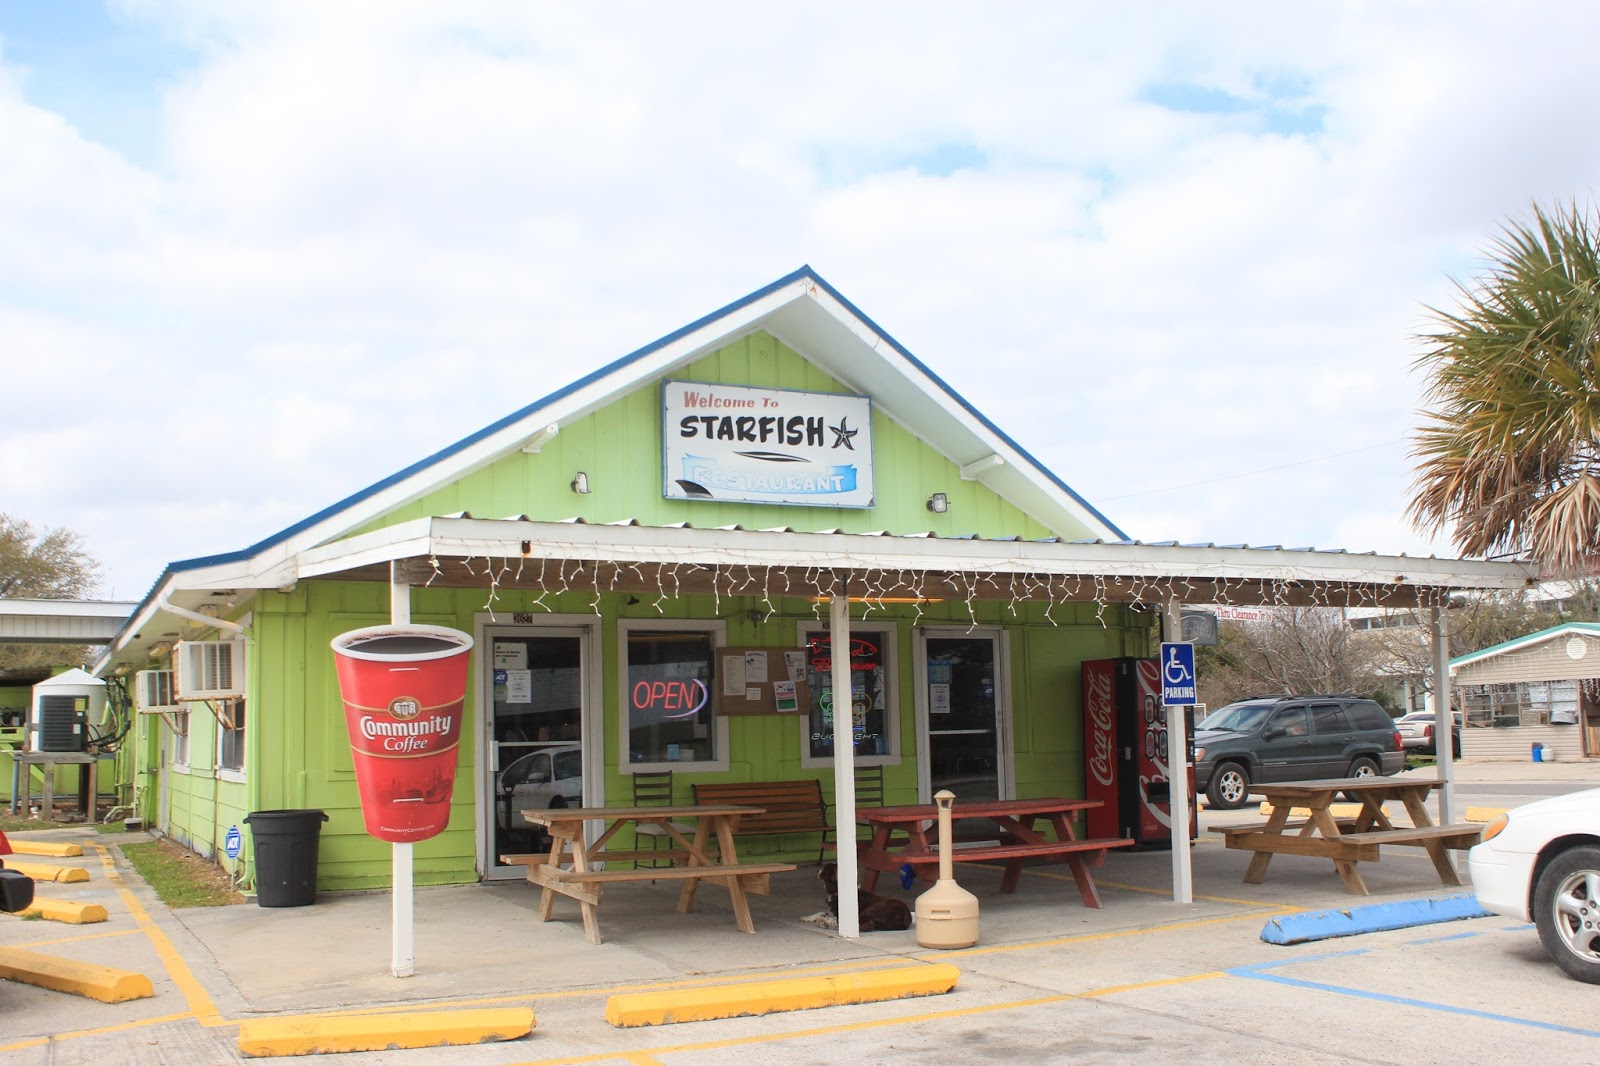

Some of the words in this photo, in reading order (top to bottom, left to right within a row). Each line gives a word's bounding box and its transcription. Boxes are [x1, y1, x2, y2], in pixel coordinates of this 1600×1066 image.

[684, 391, 755, 408] Welcome
[762, 398, 779, 408] To
[680, 415, 824, 447] STARFISH
[693, 467, 844, 492] RESTAURANT
[1216, 607, 1230, 618] Thru
[1232, 608, 1258, 620] Clearance
[633, 681, 696, 709] OPEN
[1165, 687, 1194, 698] PARKING
[360, 715, 451, 740] Community
[384, 736, 428, 753] Coffee
